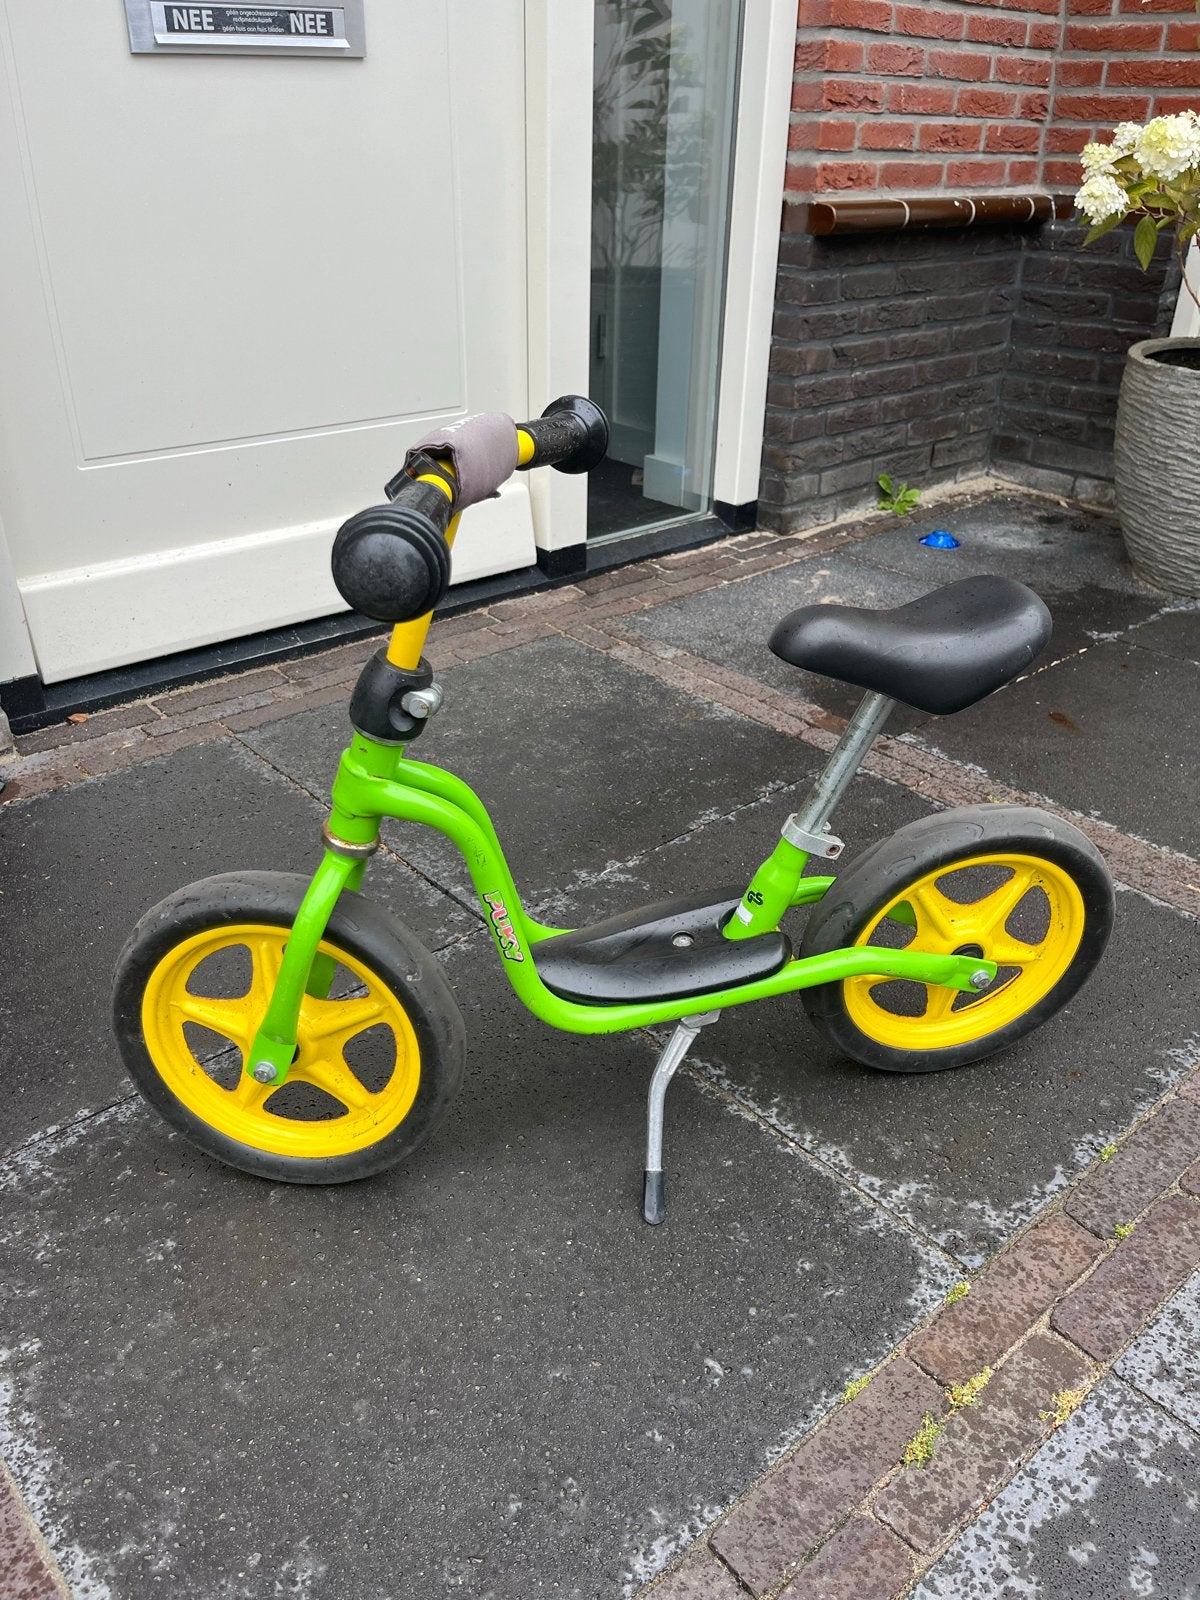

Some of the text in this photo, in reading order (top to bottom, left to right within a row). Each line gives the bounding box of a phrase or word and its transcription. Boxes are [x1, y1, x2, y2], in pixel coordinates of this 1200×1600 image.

[172, 8, 215, 31] NEE
[289, 13, 328, 34] NEE
[747, 890, 764, 906] GS
[482, 889, 525, 963] PUKY
